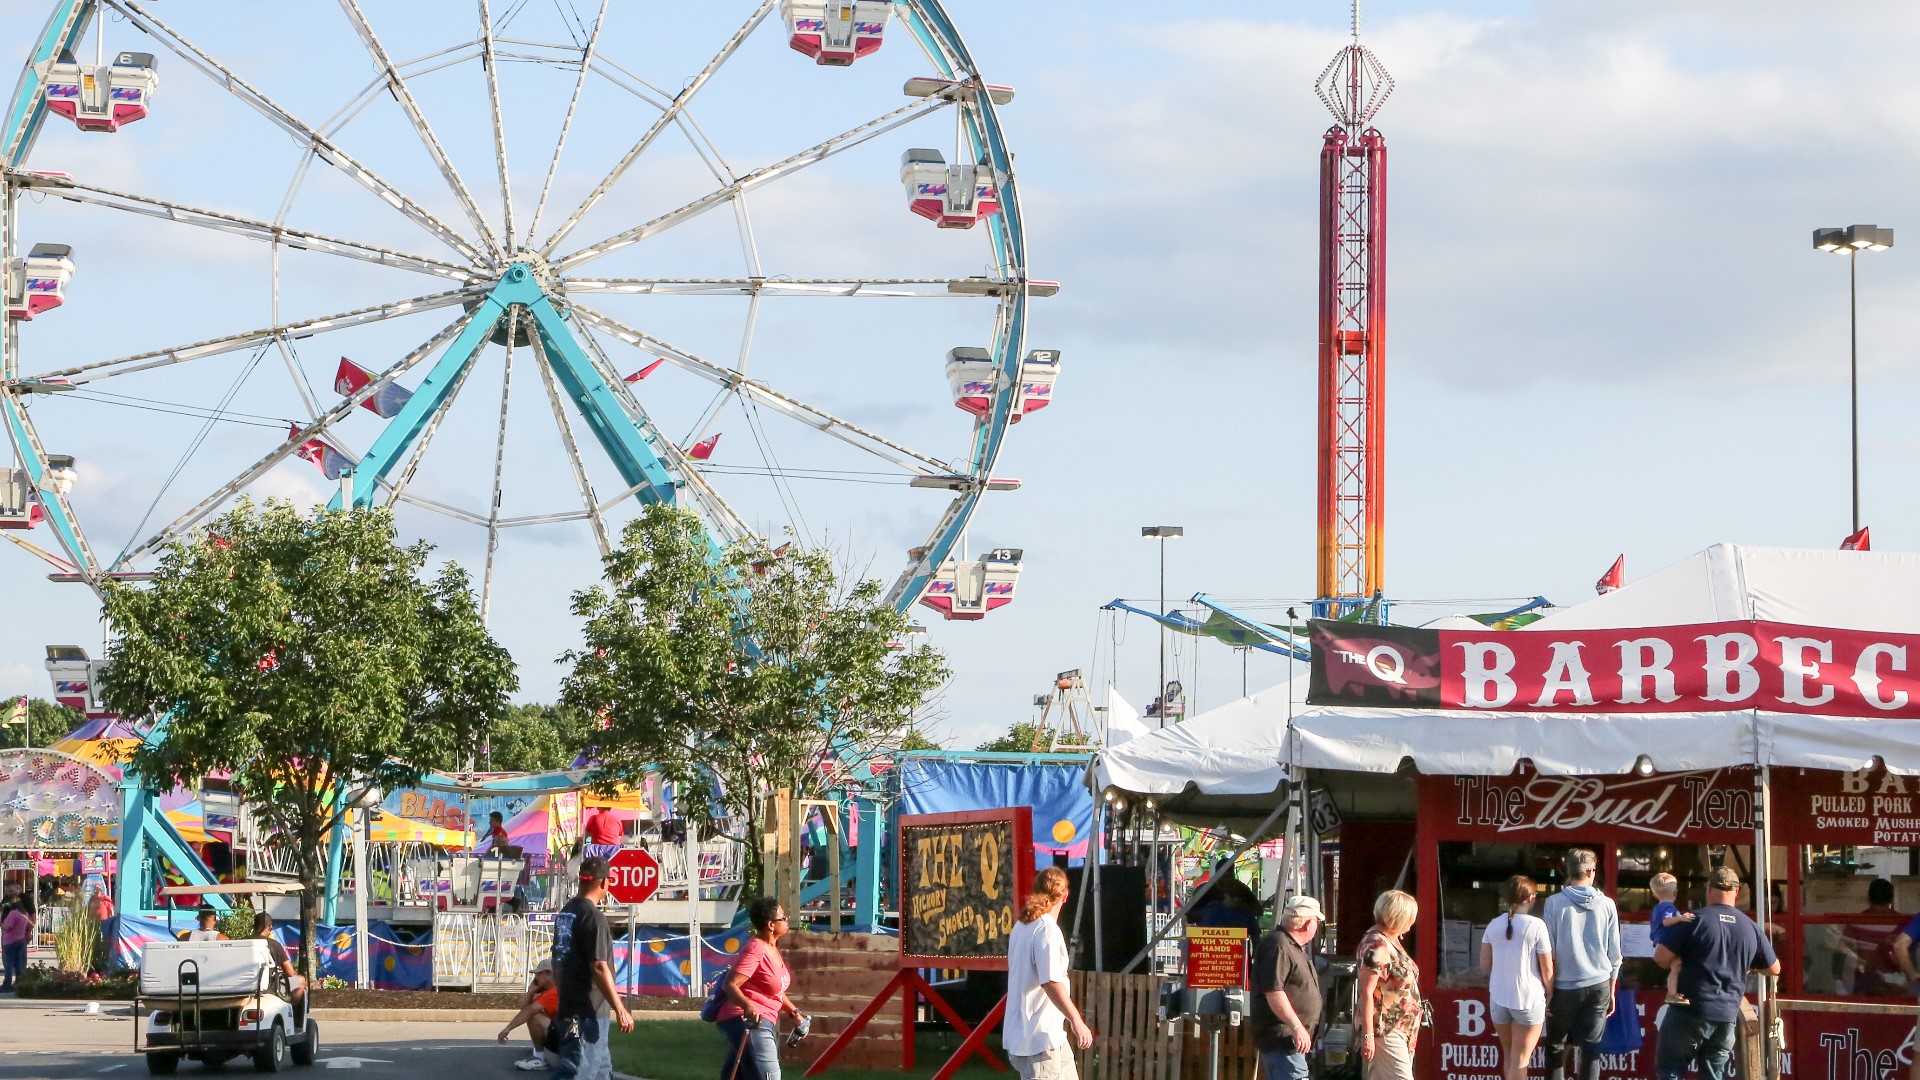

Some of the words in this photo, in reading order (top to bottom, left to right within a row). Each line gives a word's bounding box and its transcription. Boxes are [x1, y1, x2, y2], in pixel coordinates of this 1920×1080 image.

[120, 53, 132, 64] 6
[1033, 351, 1052, 362] 12
[993, 550, 1012, 561] 13
[1333, 650, 1366, 665] THE
[1366, 645, 1408, 685] Q
[1452, 632, 1909, 710] BARBEC
[1841, 769, 1920, 794] BA
[1454, 774, 1526, 826] The
[1525, 778, 1668, 829] Bud
[1811, 794, 1866, 816] PULLED
[1872, 795, 1913, 817] PORK
[1816, 816, 1870, 830] SMOKED
[1873, 830, 1920, 844] POTAT
[917, 833, 963, 889] THE
[609, 866, 656, 887] STOP
[938, 906, 974, 950] SMOKED
[1440, 1042, 1499, 1071] PULLED
